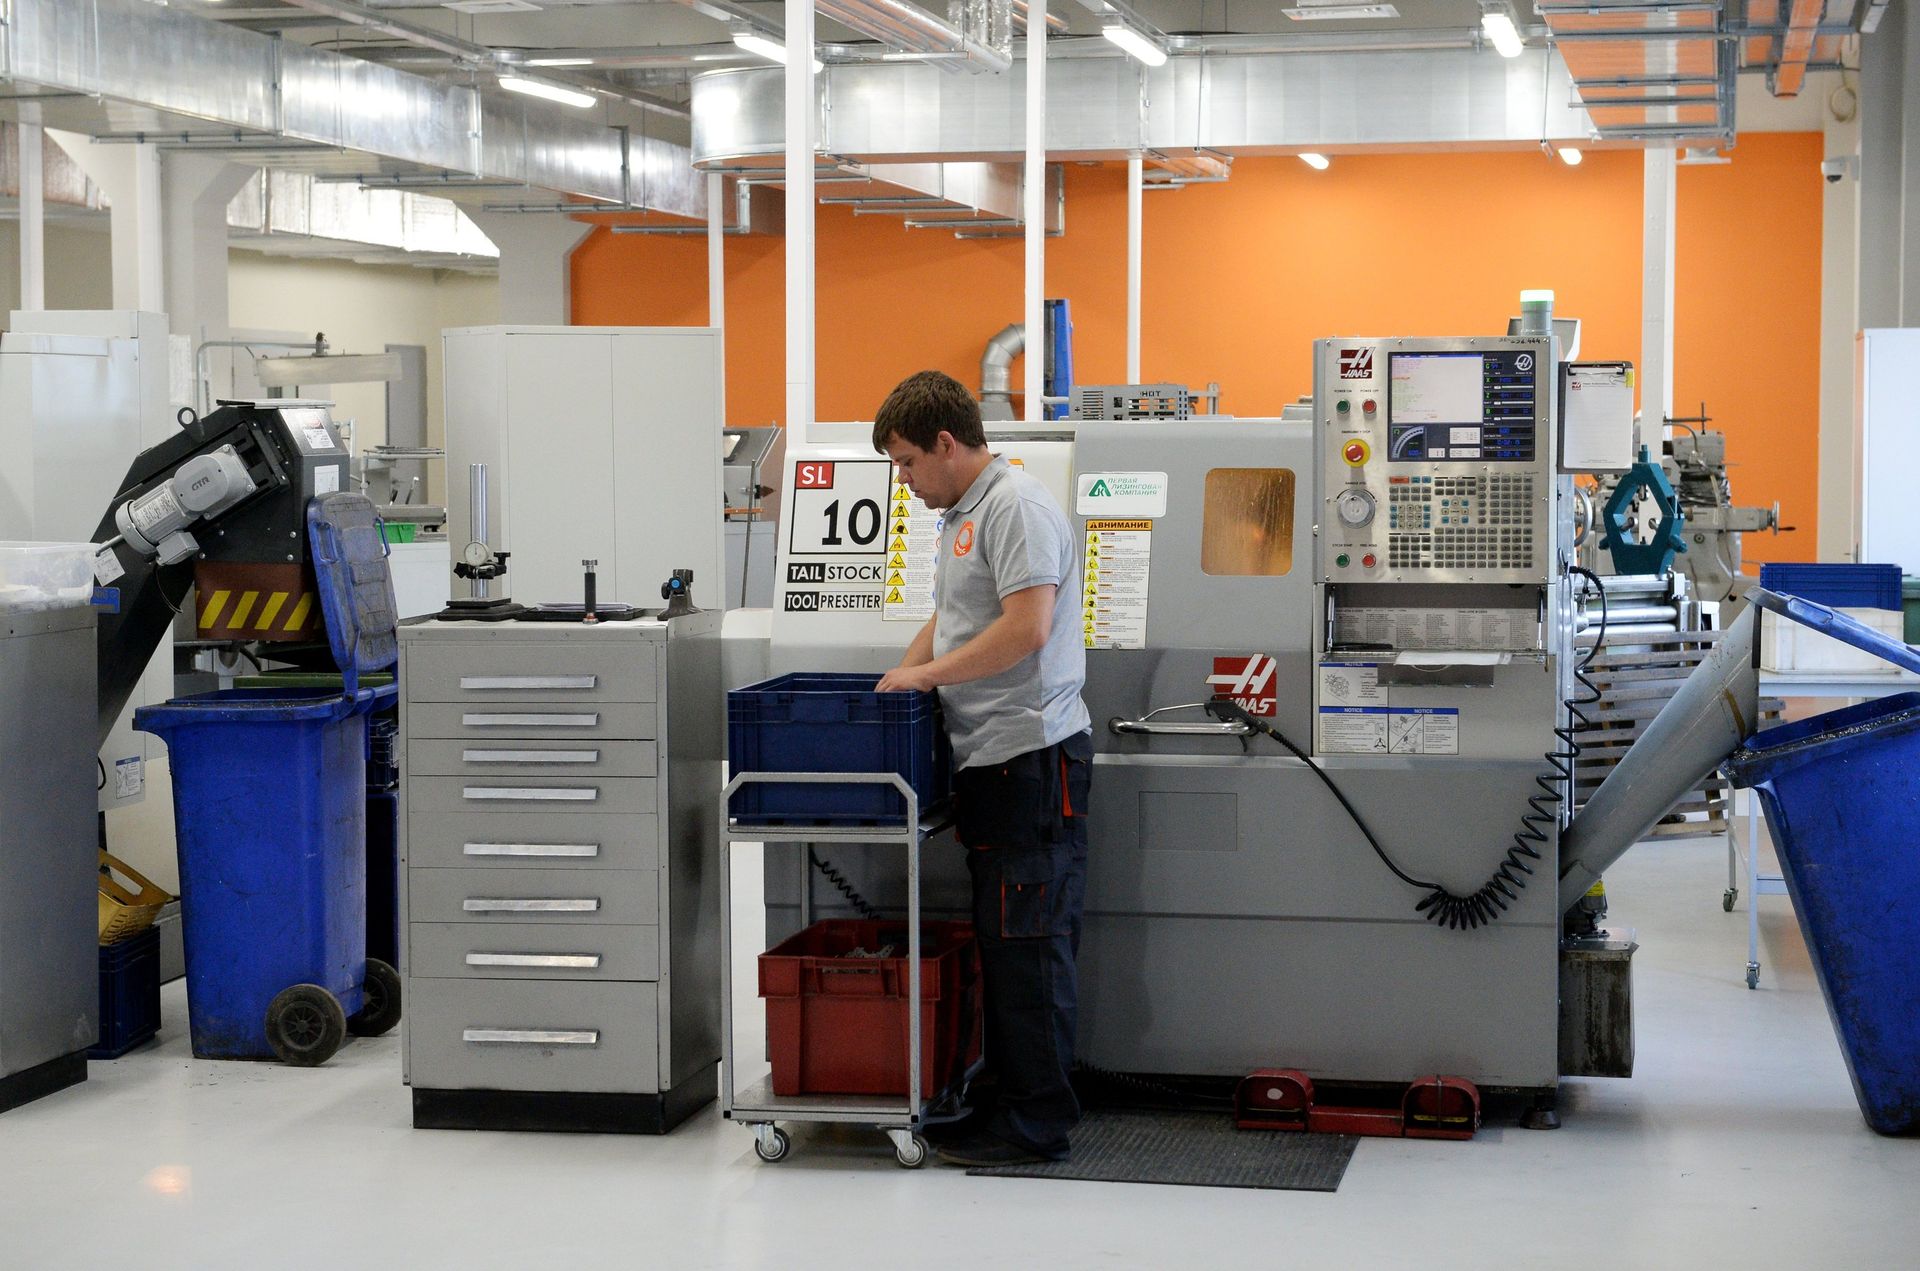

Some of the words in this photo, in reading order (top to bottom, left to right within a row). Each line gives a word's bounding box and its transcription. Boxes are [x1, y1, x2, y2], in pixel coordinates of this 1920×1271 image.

[1341, 369, 1372, 378] HAAS
[802, 466, 827, 485] SL
[192, 476, 210, 492] GTR
[822, 498, 881, 546] 10
[790, 566, 822, 580] TAIL
[827, 566, 882, 580] STOCK
[786, 595, 818, 609] TOOL
[820, 595, 881, 608] PRESETTER
